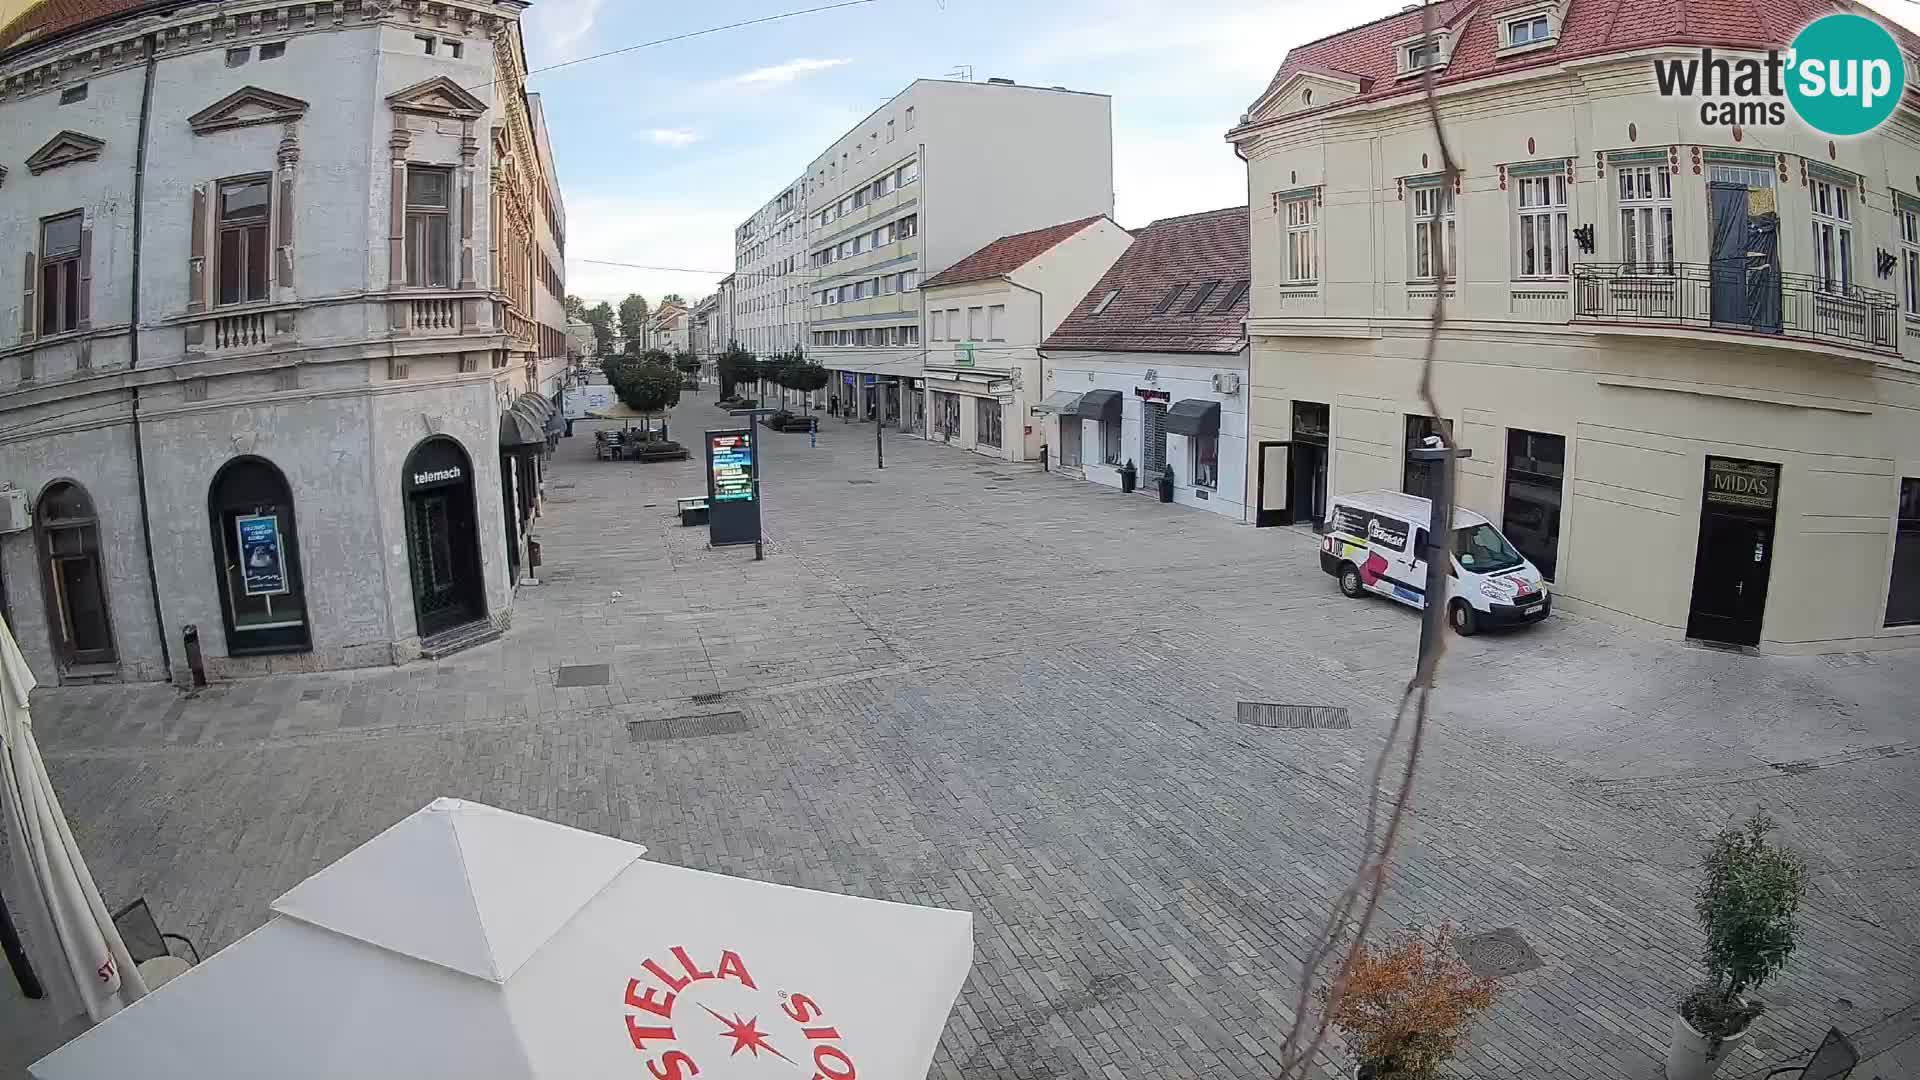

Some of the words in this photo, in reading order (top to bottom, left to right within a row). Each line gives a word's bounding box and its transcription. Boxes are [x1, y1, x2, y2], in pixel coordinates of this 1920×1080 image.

[414, 466, 461, 485] telemach
[1714, 473, 1769, 495] MIDAS
[624, 945, 758, 1080] STELLA
[781, 992, 856, 1080] OIS
